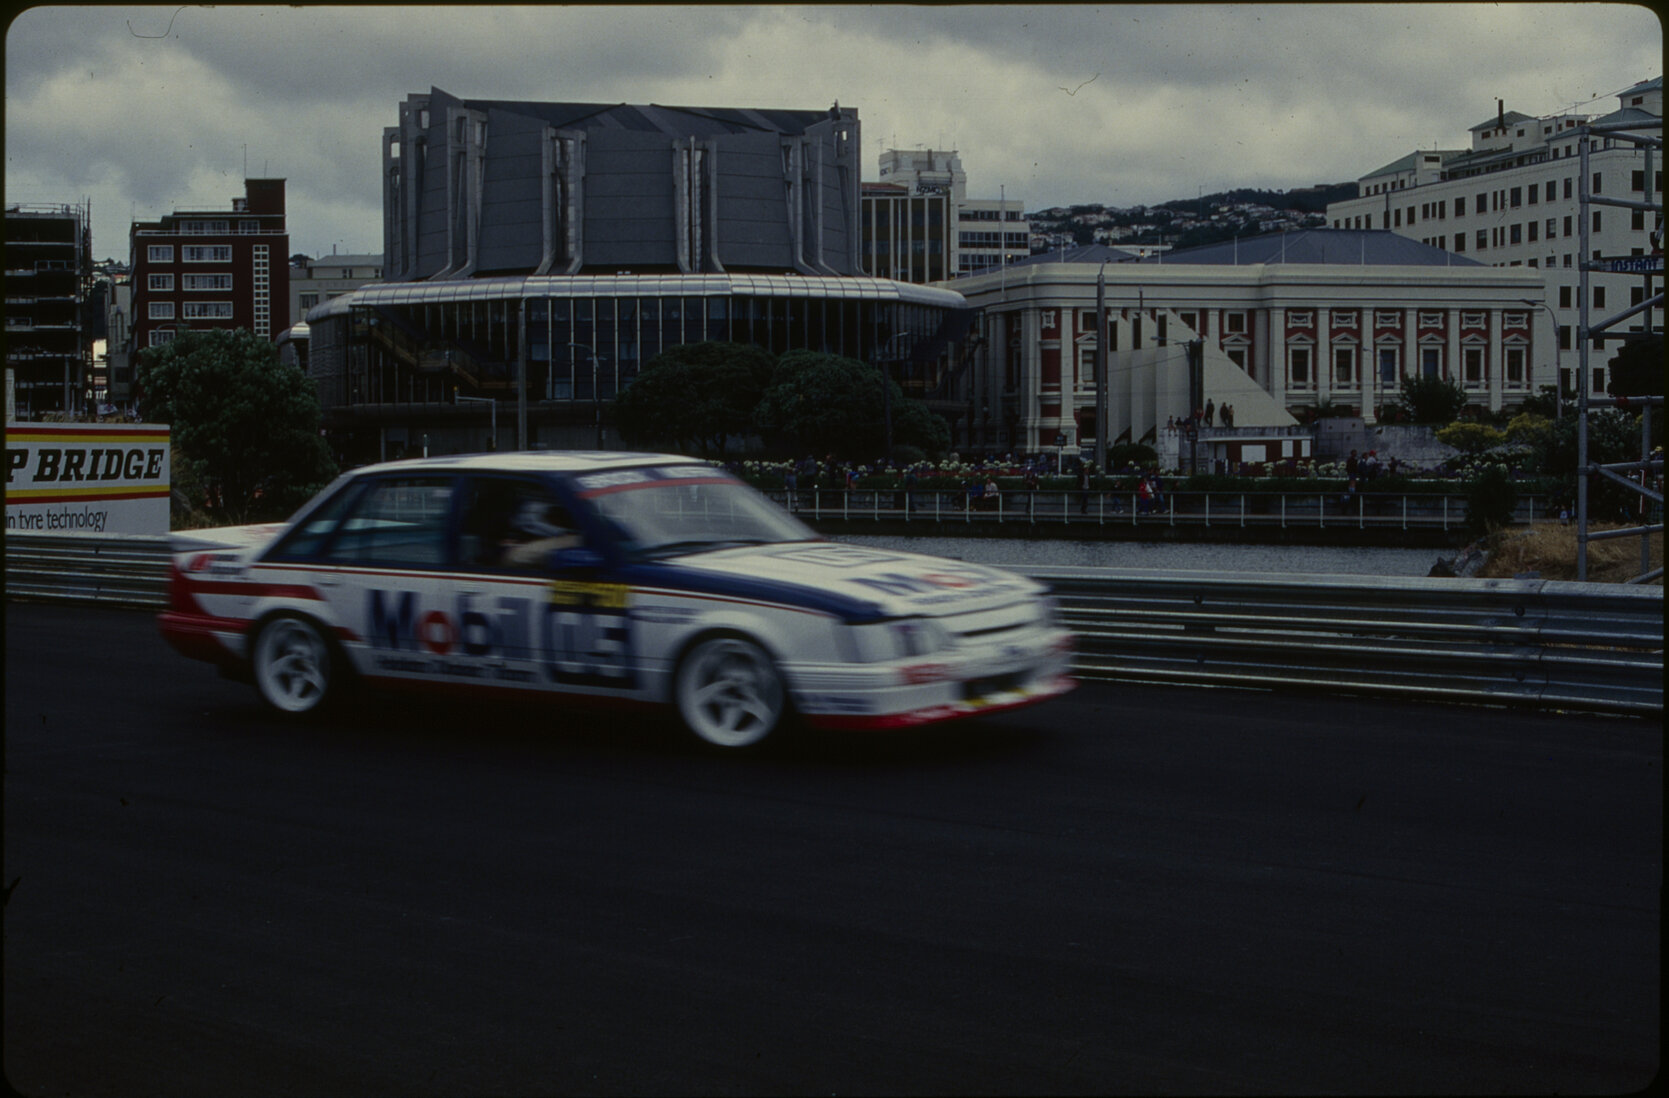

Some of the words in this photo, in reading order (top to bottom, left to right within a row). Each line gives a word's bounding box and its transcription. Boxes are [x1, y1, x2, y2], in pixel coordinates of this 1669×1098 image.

[1612, 258, 1658, 272] INSTANT
[33, 449, 164, 482] BRIDGE
[19, 510, 43, 530] tyre
[47, 506, 108, 532] technology
